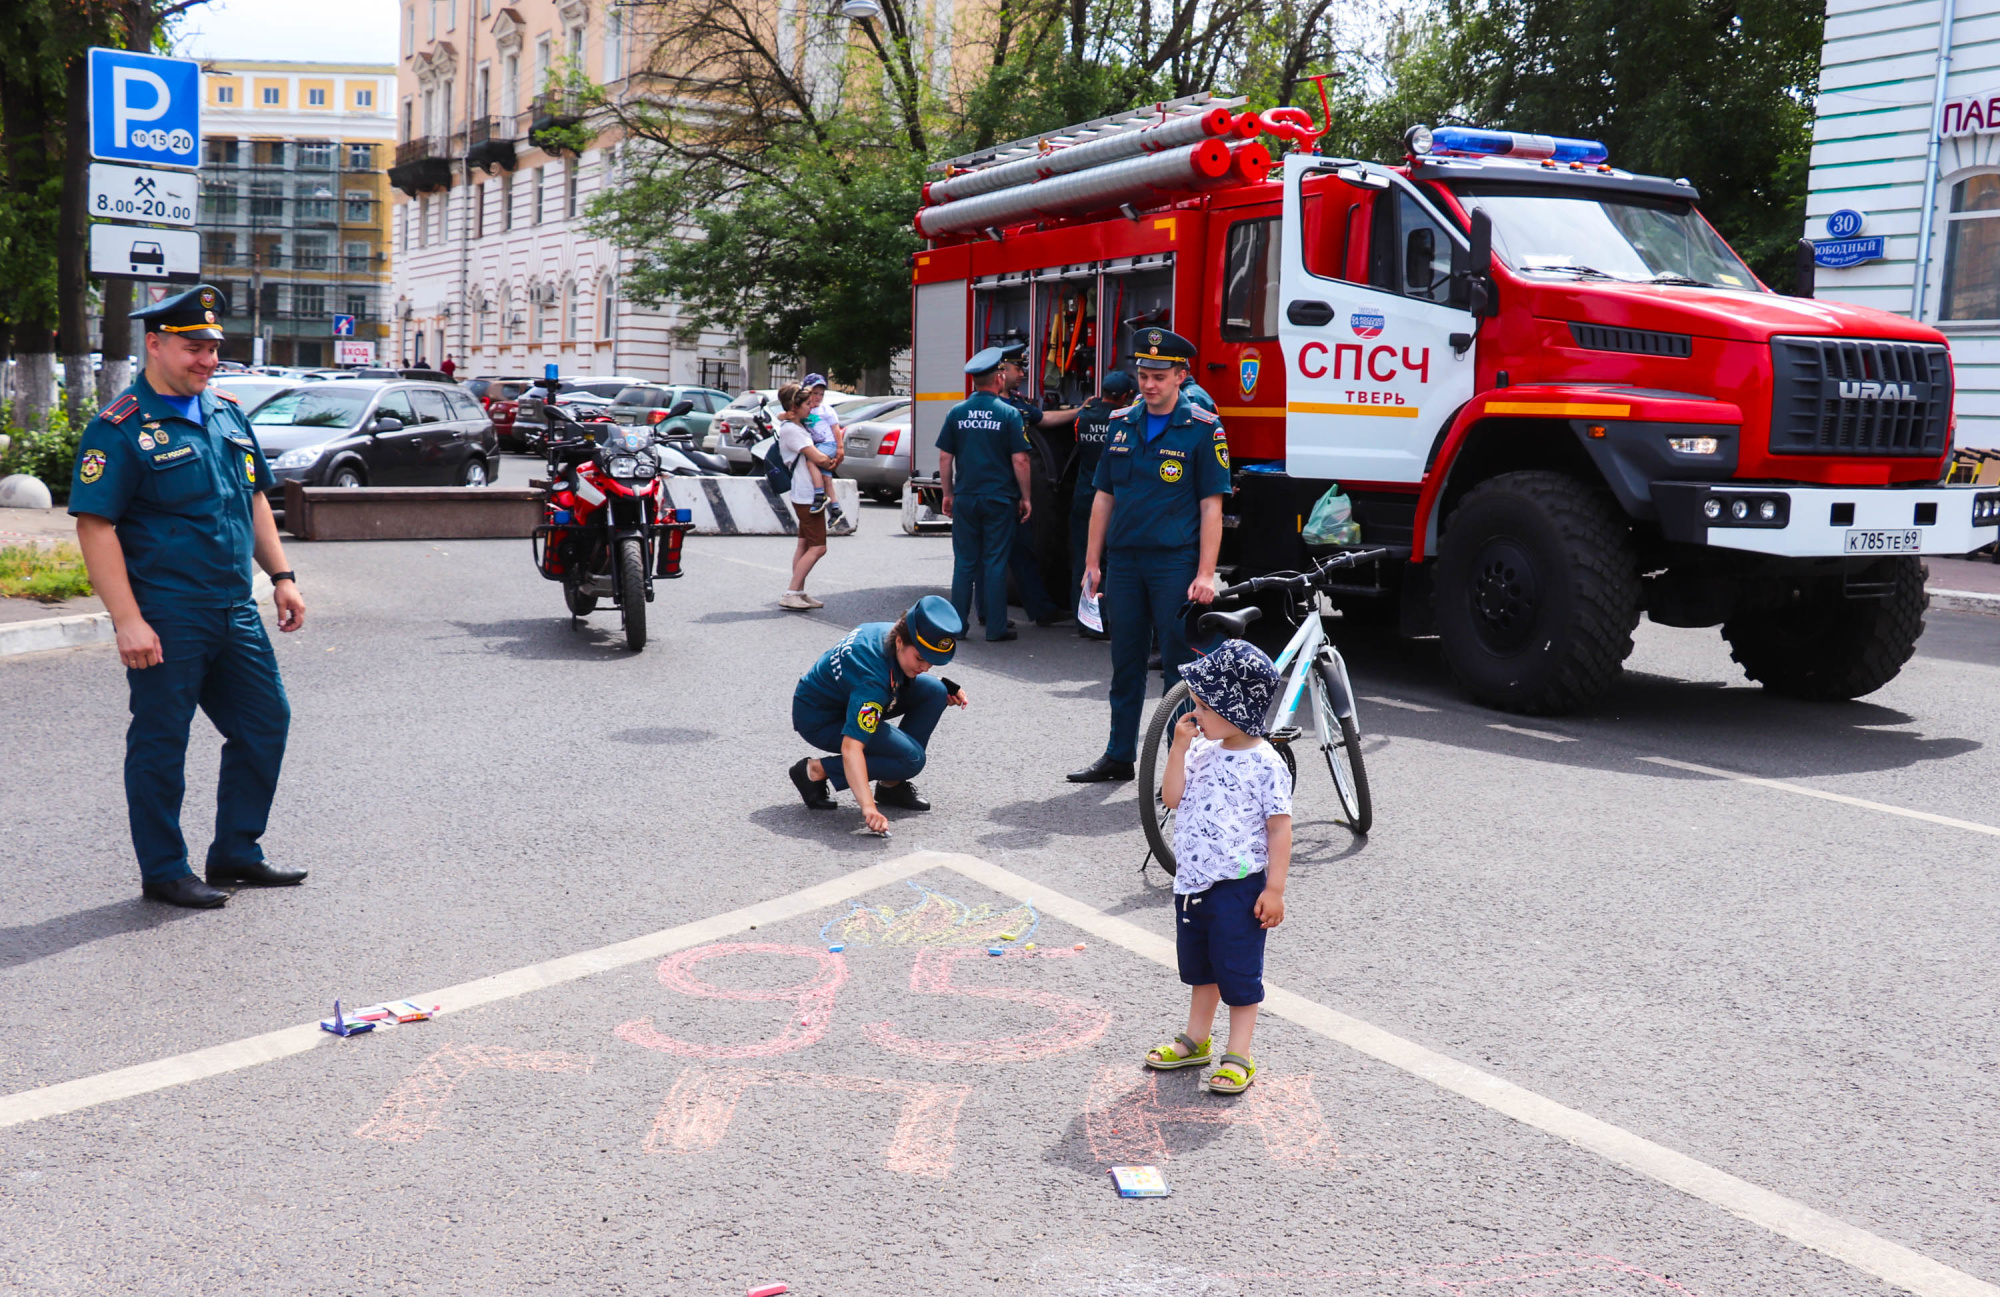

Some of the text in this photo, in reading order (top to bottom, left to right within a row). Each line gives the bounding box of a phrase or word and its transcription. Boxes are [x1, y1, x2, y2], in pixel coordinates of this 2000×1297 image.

[113, 65, 171, 148] P
[133, 133, 191, 150] 10 15 20
[97, 193, 191, 219] 8.00-20.00
[1833, 214, 1854, 232] 30
[1297, 341, 1430, 384] СПСЧ
[1345, 390, 1406, 405] ТВЕРЬ
[1838, 381, 1918, 400] URAL
[967, 410, 993, 420] МЧС
[958, 419, 1002, 431] РОССИИ
[613, 942, 1111, 1063] 95
